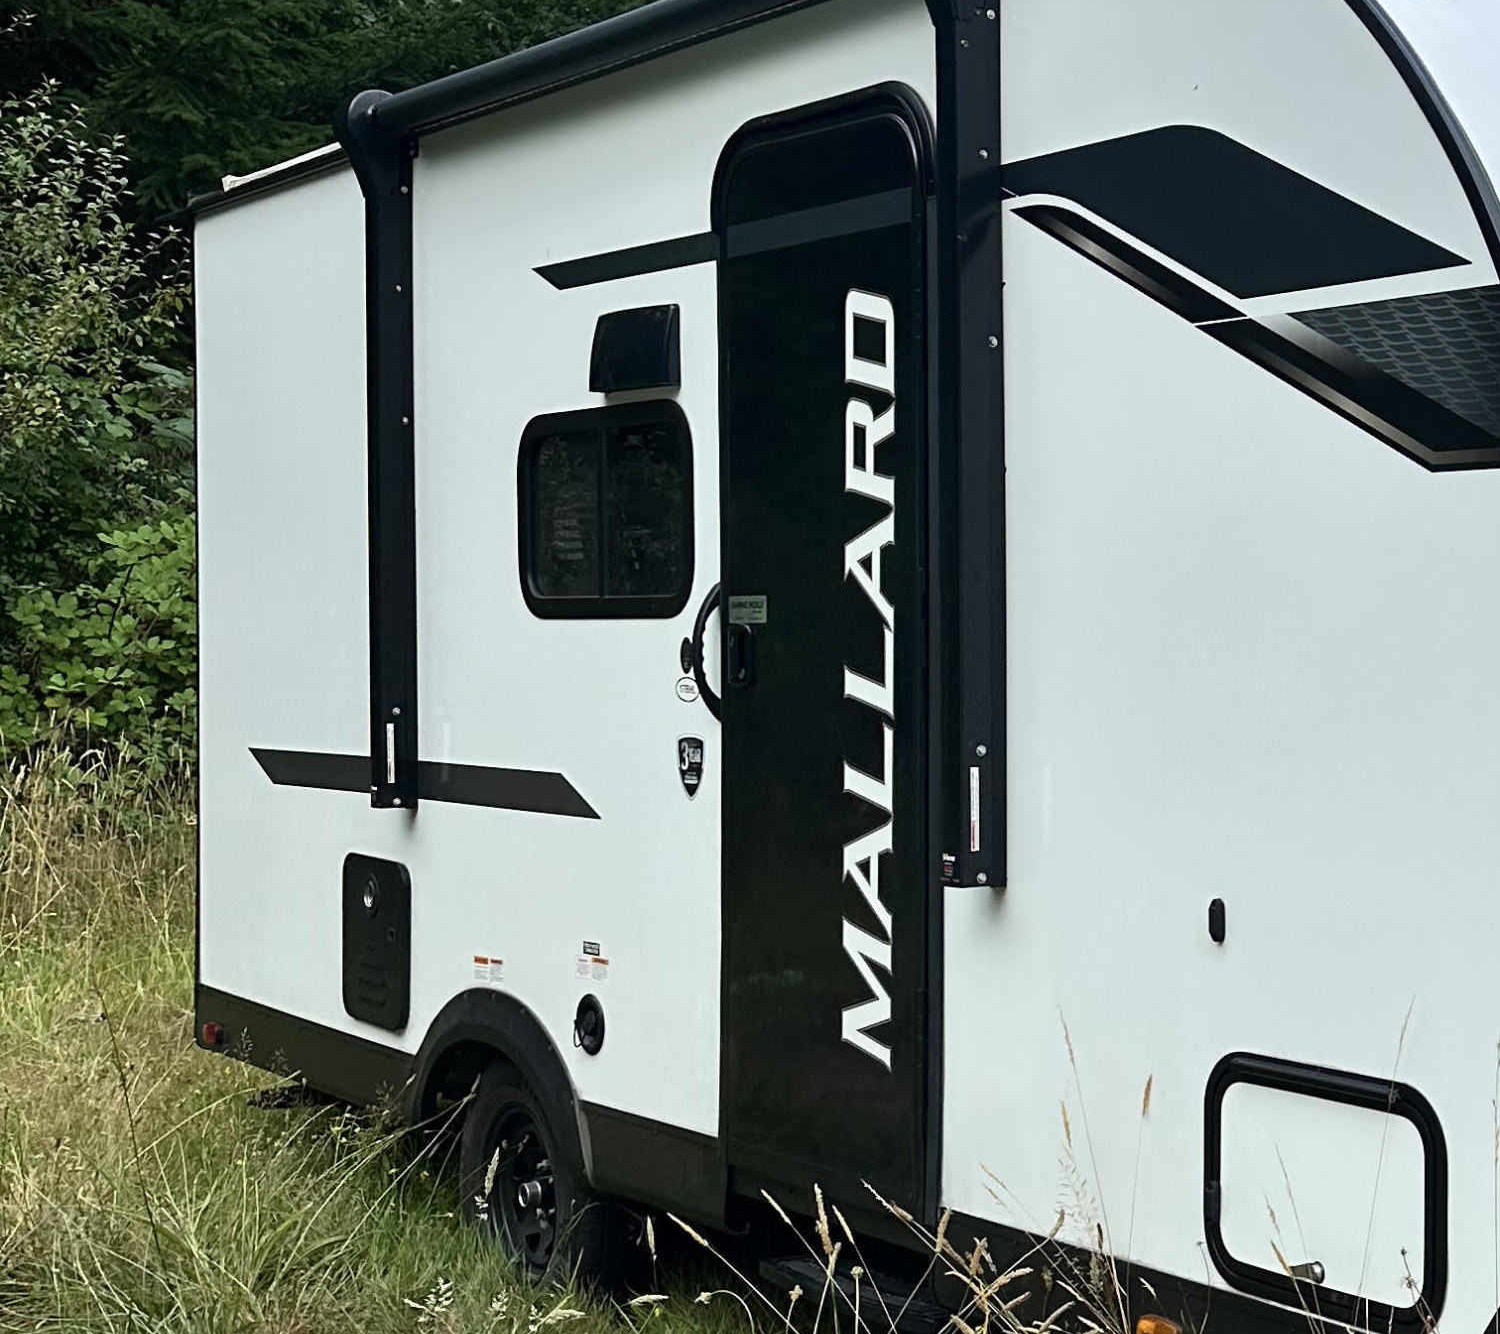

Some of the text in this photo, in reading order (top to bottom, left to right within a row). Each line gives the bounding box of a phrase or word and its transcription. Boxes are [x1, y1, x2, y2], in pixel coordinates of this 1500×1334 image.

[681, 741, 701, 771] 3 YEAR
[841, 288, 896, 1071] MALLARD
